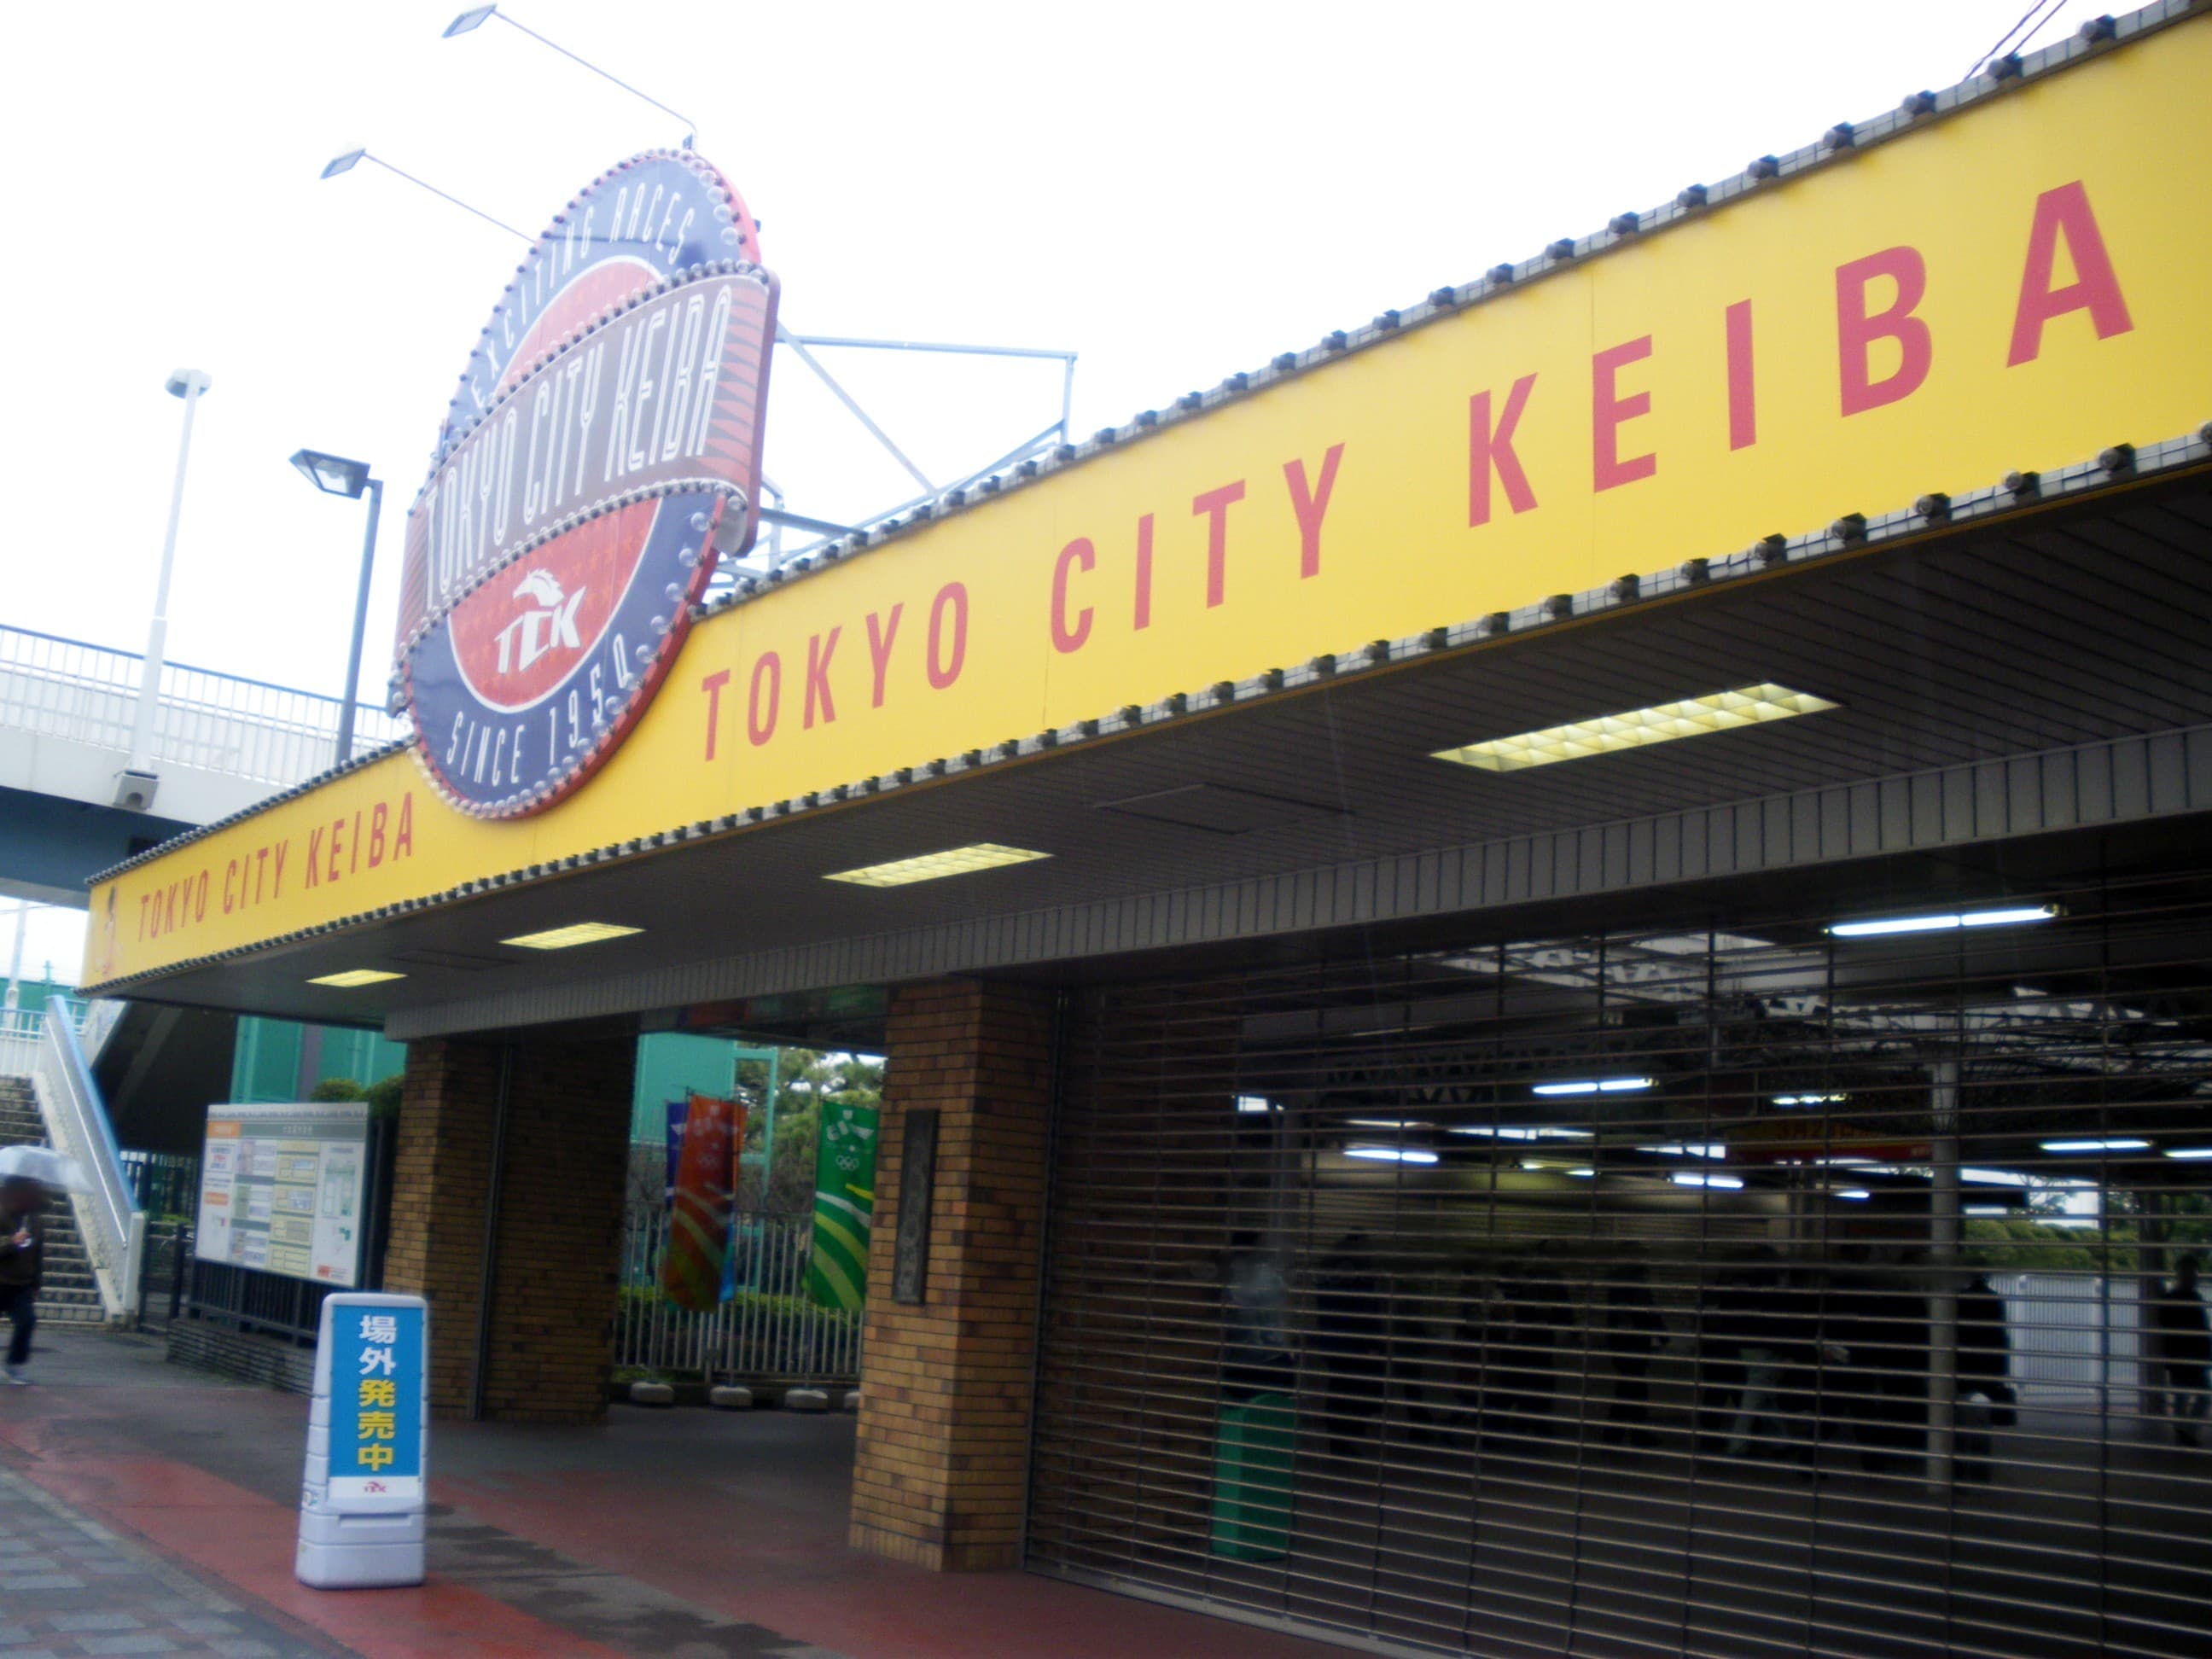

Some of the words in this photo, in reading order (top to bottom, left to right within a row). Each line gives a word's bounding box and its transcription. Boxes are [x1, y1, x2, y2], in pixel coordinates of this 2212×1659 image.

[470, 205, 595, 410] EXCITING
[610, 182, 696, 265] RACES
[425, 406, 517, 610] TOKYO
[522, 341, 605, 526] CITY
[604, 284, 732, 482] KEIBA
[701, 581, 969, 762] TOKYO
[1051, 441, 1346, 654] CITY
[1468, 179, 2135, 529] KEIBA
[494, 585, 587, 674] TCK
[446, 711, 526, 788] SINCE
[548, 633, 632, 765] 1950
[138, 869, 210, 943] TOKYO
[224, 839, 289, 915] CITY
[304, 791, 412, 890] KEIBA
[357, 1314, 397, 1472] 場外発売中
